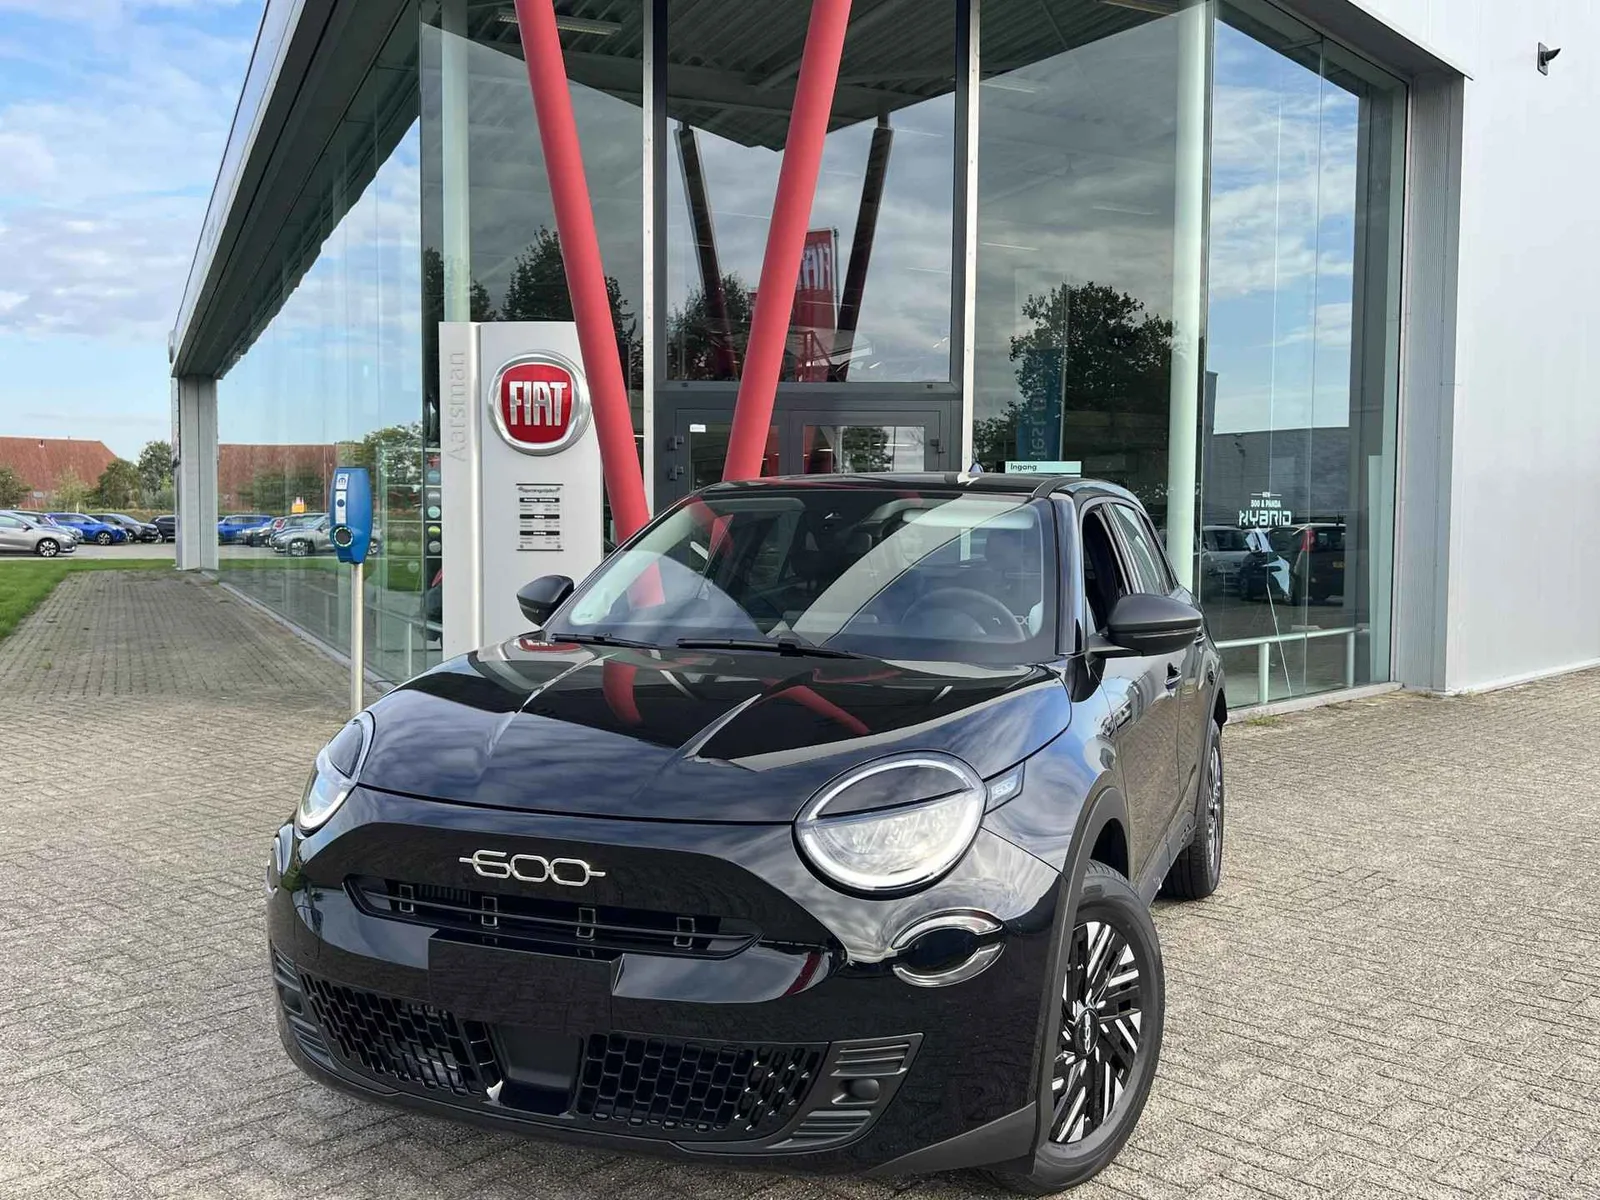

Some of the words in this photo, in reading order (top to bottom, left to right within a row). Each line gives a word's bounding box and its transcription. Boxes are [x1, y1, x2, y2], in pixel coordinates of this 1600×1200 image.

[509, 380, 567, 426] FIAT
[1010, 461, 1037, 472] Ingang
[1239, 510, 1292, 527] HYBRID
[459, 849, 606, 887] 600
